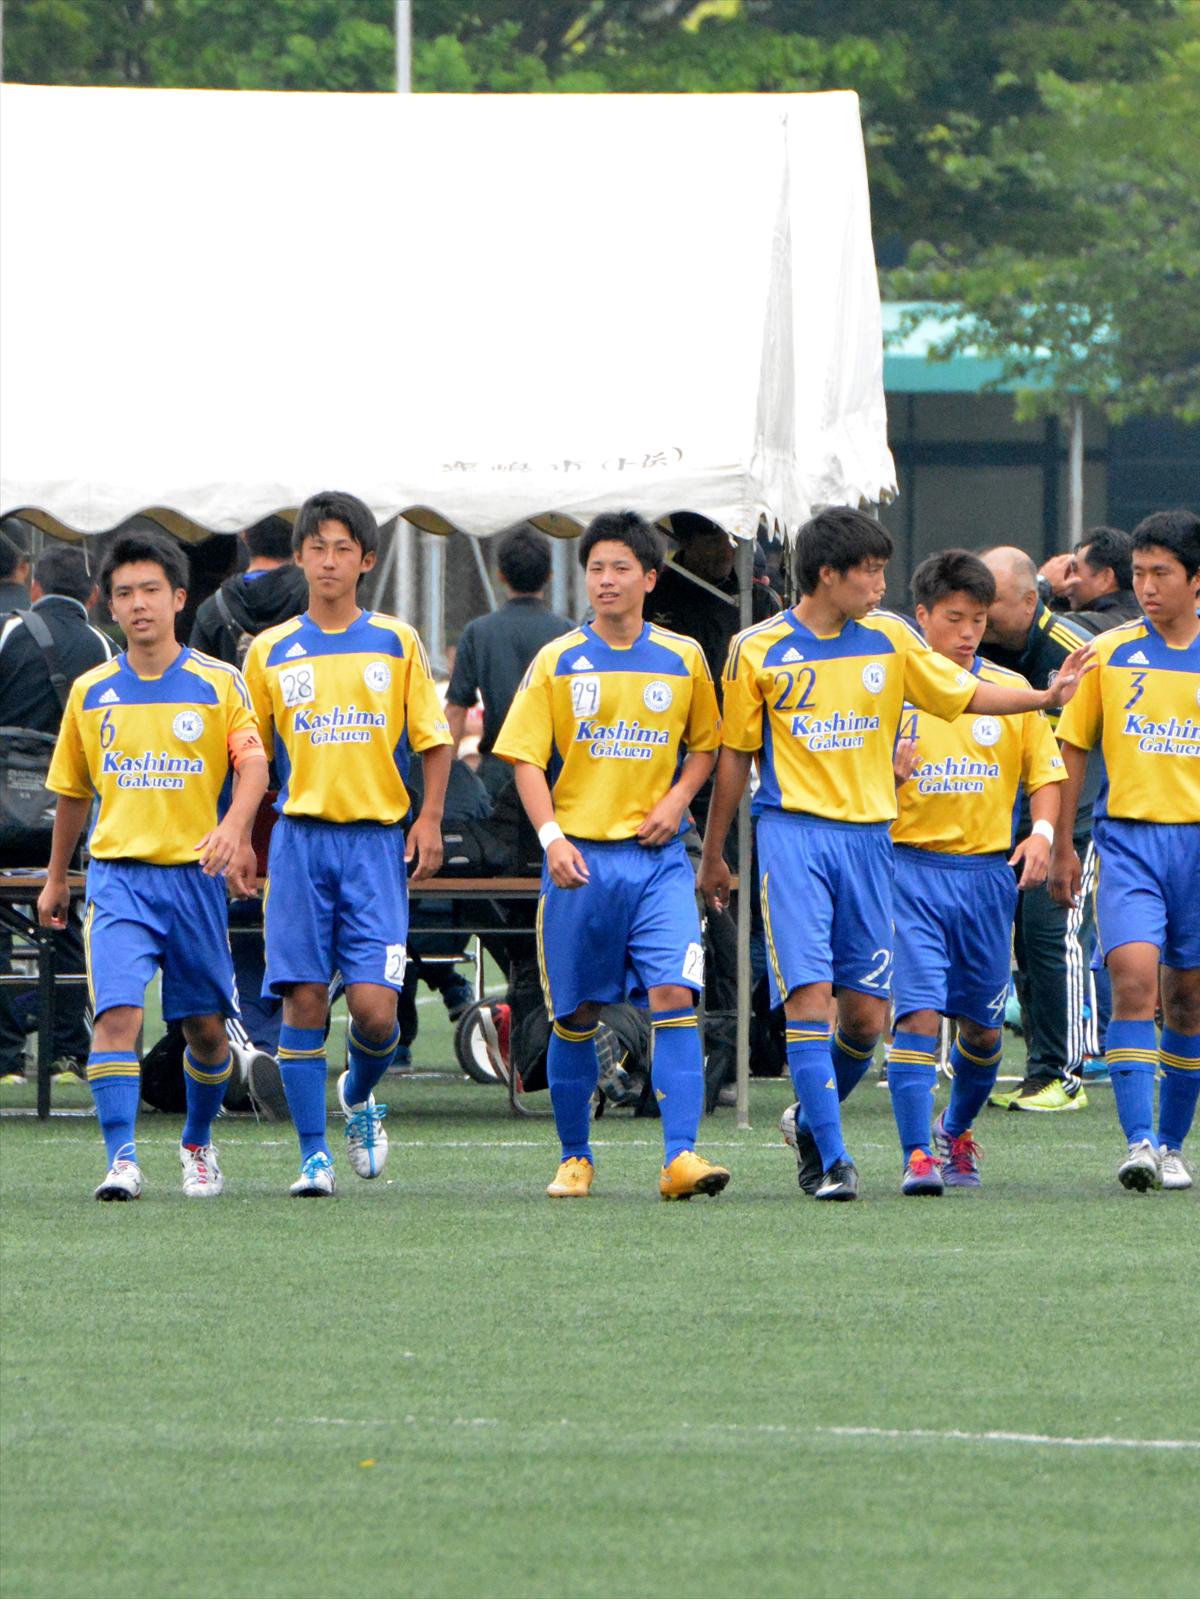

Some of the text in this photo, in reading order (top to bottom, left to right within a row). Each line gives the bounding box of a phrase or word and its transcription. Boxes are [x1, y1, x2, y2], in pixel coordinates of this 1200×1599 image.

[283, 670, 312, 703] 28
[573, 681, 597, 712] 29
[773, 667, 816, 711] 22
[1123, 672, 1148, 710] 3
[100, 709, 116, 750] 6
[294, 705, 387, 733] Kashima
[575, 719, 670, 745] Kashima
[791, 711, 881, 737] Kashima
[899, 713, 921, 742] 4
[310, 728, 371, 746] Gakuen
[807, 735, 865, 752] Gakuen
[102, 750, 204, 774] Kashima
[589, 741, 653, 760] Gakuen
[909, 756, 1001, 779] ashima
[117, 772, 185, 790] Gakuen
[918, 776, 985, 794] Gakuen
[987, 982, 1010, 1019] 4
